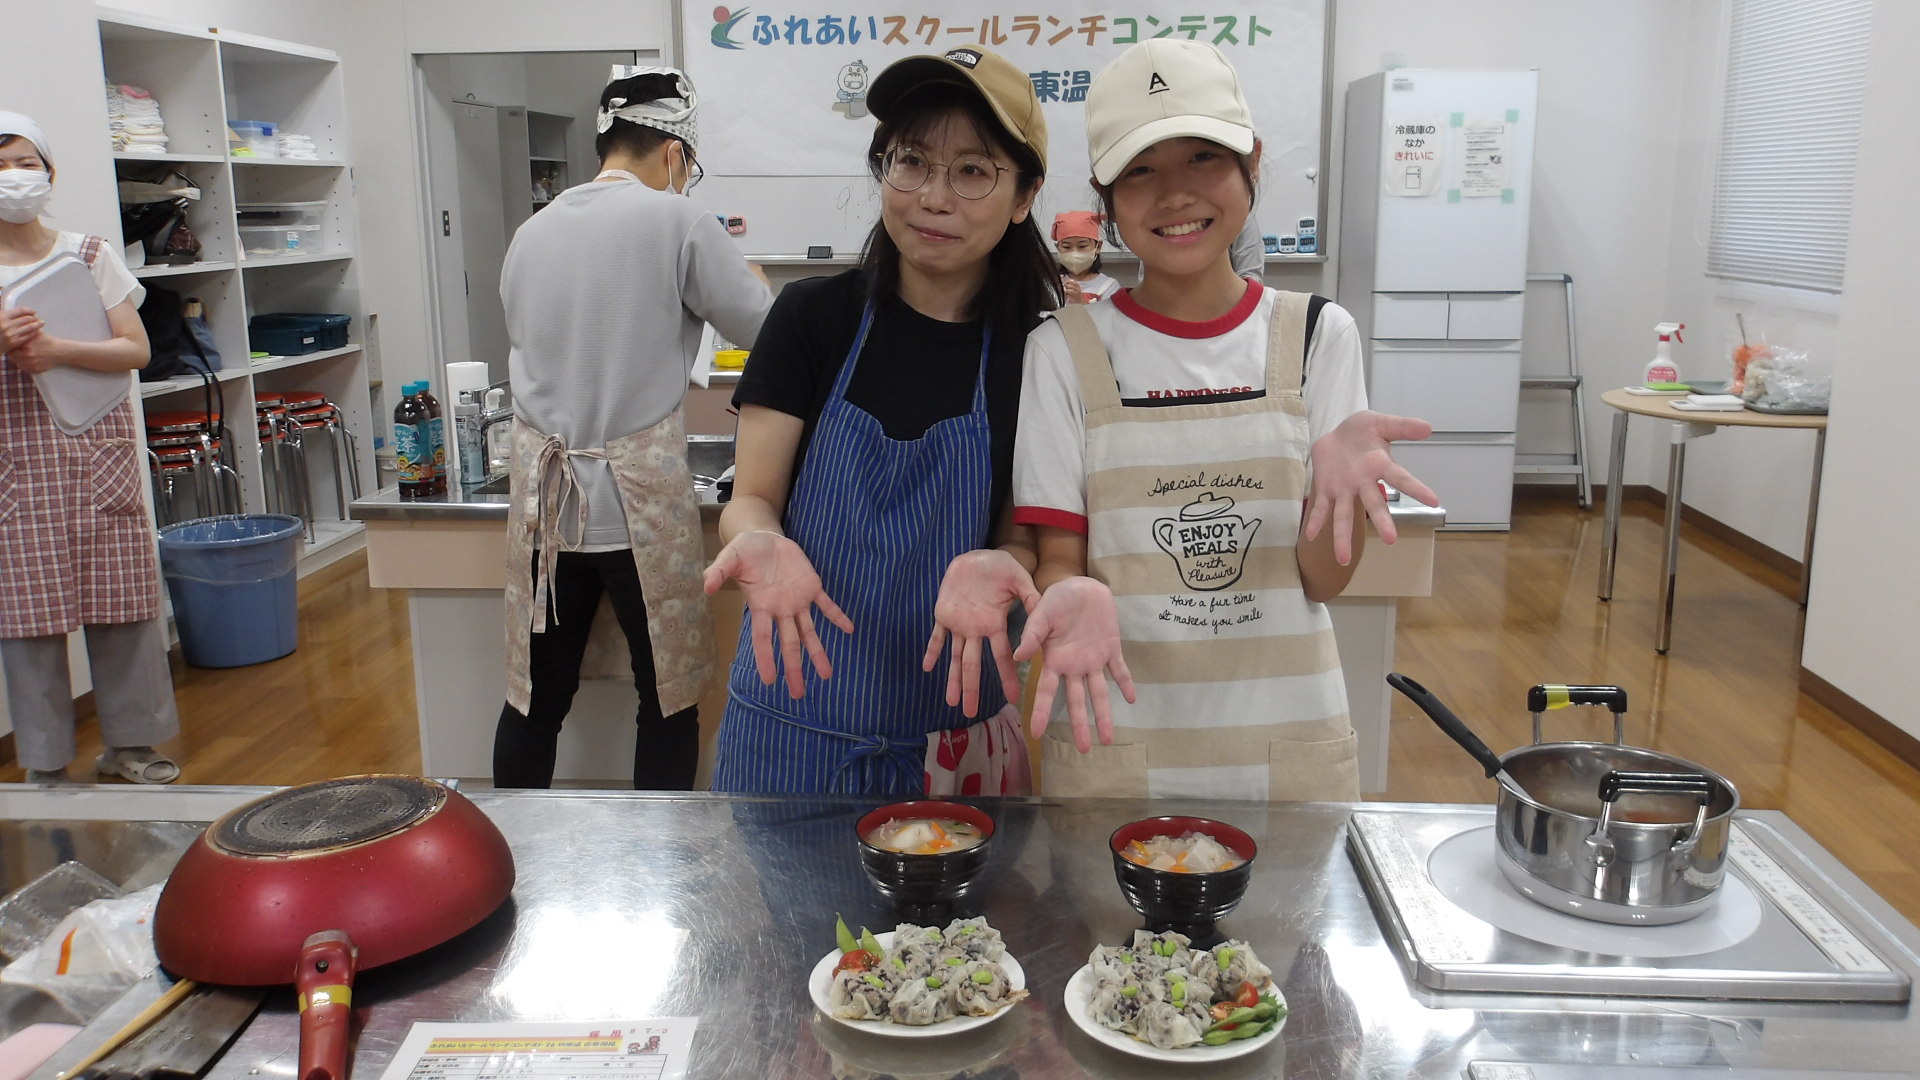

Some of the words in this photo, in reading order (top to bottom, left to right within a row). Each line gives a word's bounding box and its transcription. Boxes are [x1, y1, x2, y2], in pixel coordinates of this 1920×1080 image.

[752, 15, 1273, 47] ふれあいスクールランチコンテスト
[1149, 72, 1168, 91] A
[1394, 124, 1436, 135] 冷蔵庫の
[1404, 138, 1425, 148] なか
[1394, 151, 1434, 161] きれいに
[1147, 471, 1206, 497] Special
[1210, 474, 1264, 489] dishes
[1178, 522, 1237, 544] ENJOY
[1182, 540, 1238, 559] MEALS
[1195, 556, 1227, 569] with
[1187, 566, 1237, 582] Pleasure
[1169, 594, 1197, 607] Have
[1233, 592, 1256, 605] time
[1158, 609, 1173, 621] It
[1173, 614, 1208, 626] makes
[1211, 618, 1234, 635] you
[1236, 606, 1263, 623] smile
